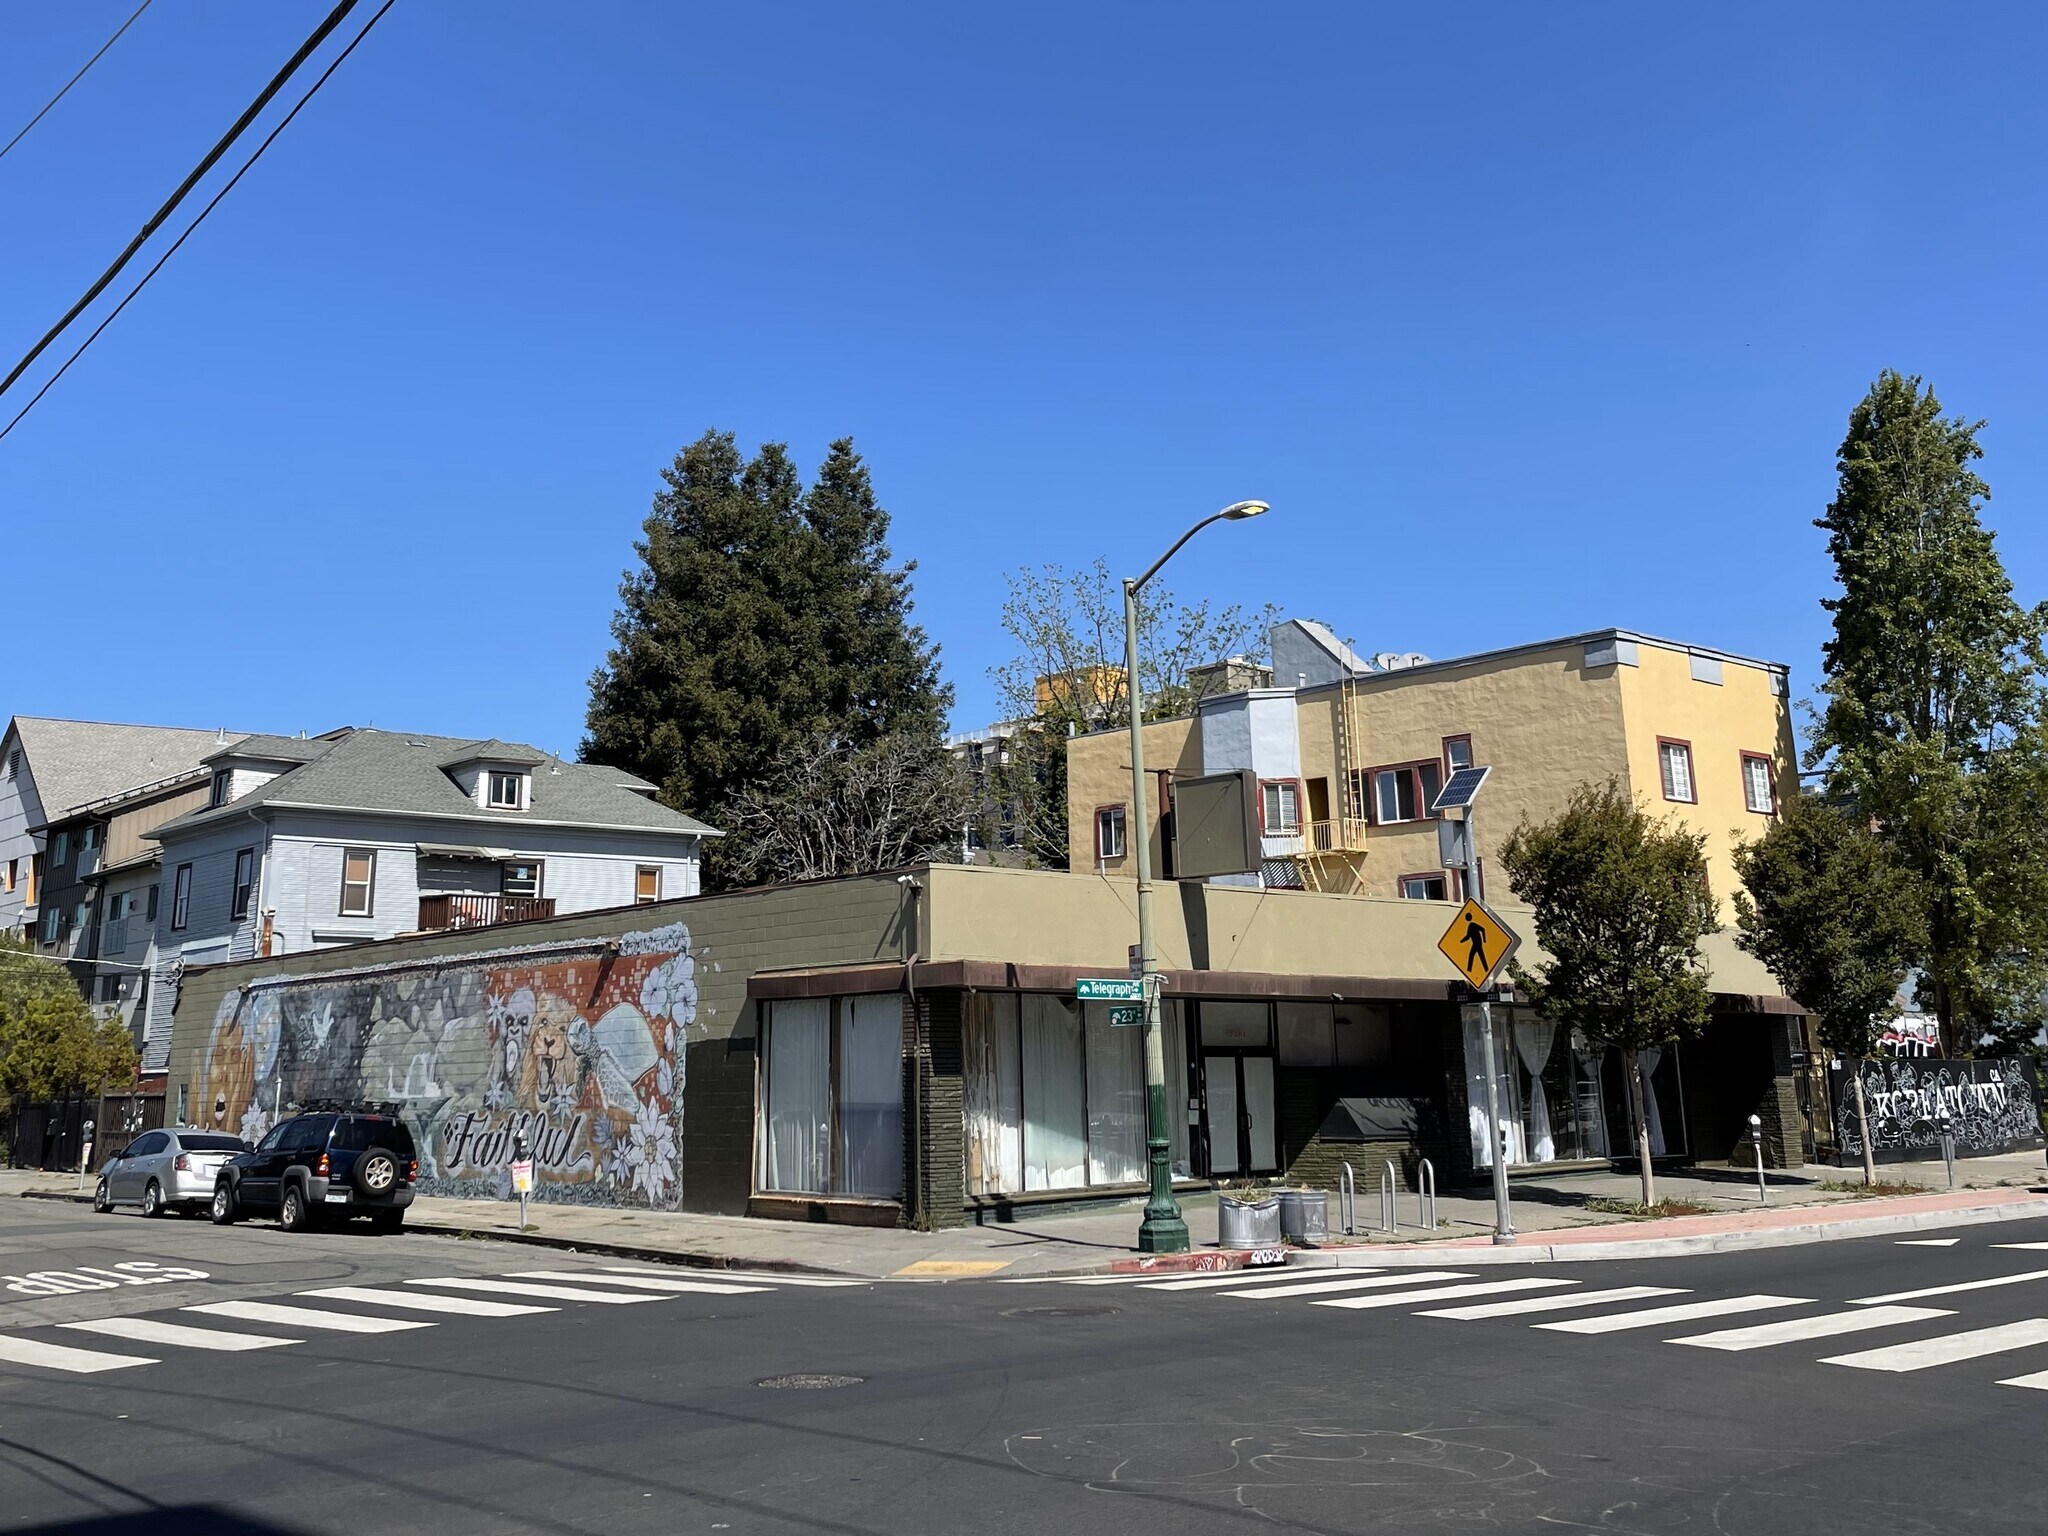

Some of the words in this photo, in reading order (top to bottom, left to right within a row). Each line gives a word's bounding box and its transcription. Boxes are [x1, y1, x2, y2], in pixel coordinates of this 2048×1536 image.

[1090, 981, 1131, 998] Telegraph
[1989, 1069, 2001, 1082] CA
[1, 1261, 211, 1295] STOP
